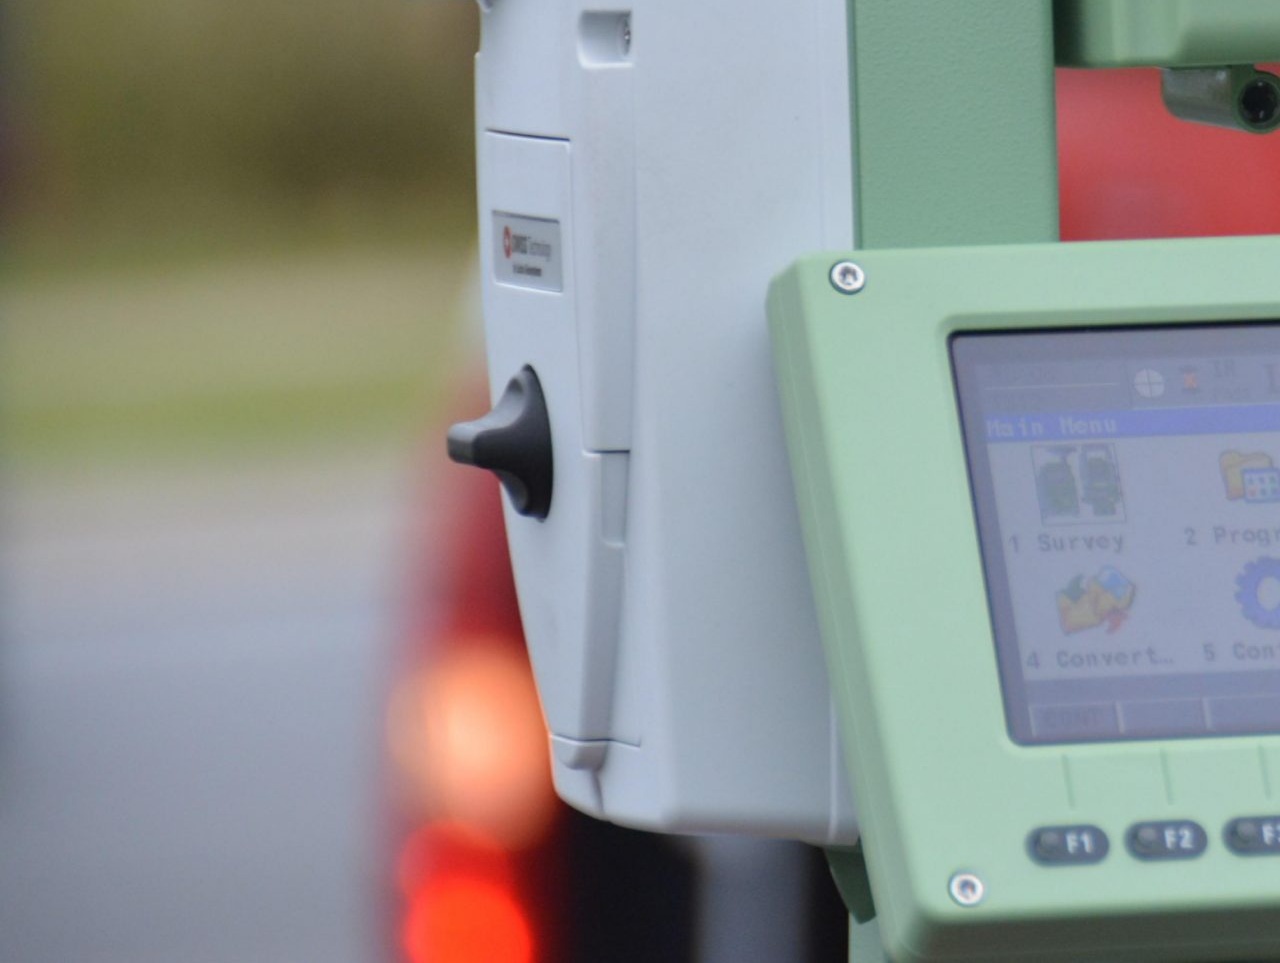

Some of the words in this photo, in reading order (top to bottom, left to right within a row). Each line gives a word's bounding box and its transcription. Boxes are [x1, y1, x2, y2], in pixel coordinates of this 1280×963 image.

[987, 418, 1043, 438] Main
[1059, 415, 1117, 435] Menu
[1010, 535, 1020, 553] 1
[1038, 533, 1123, 553] Survey
[1185, 528, 1197, 546] 2
[1026, 650, 1041, 669] 4
[1203, 643, 1216, 662] 5
[1066, 832, 1093, 854] F1
[1165, 828, 1193, 850] F2
